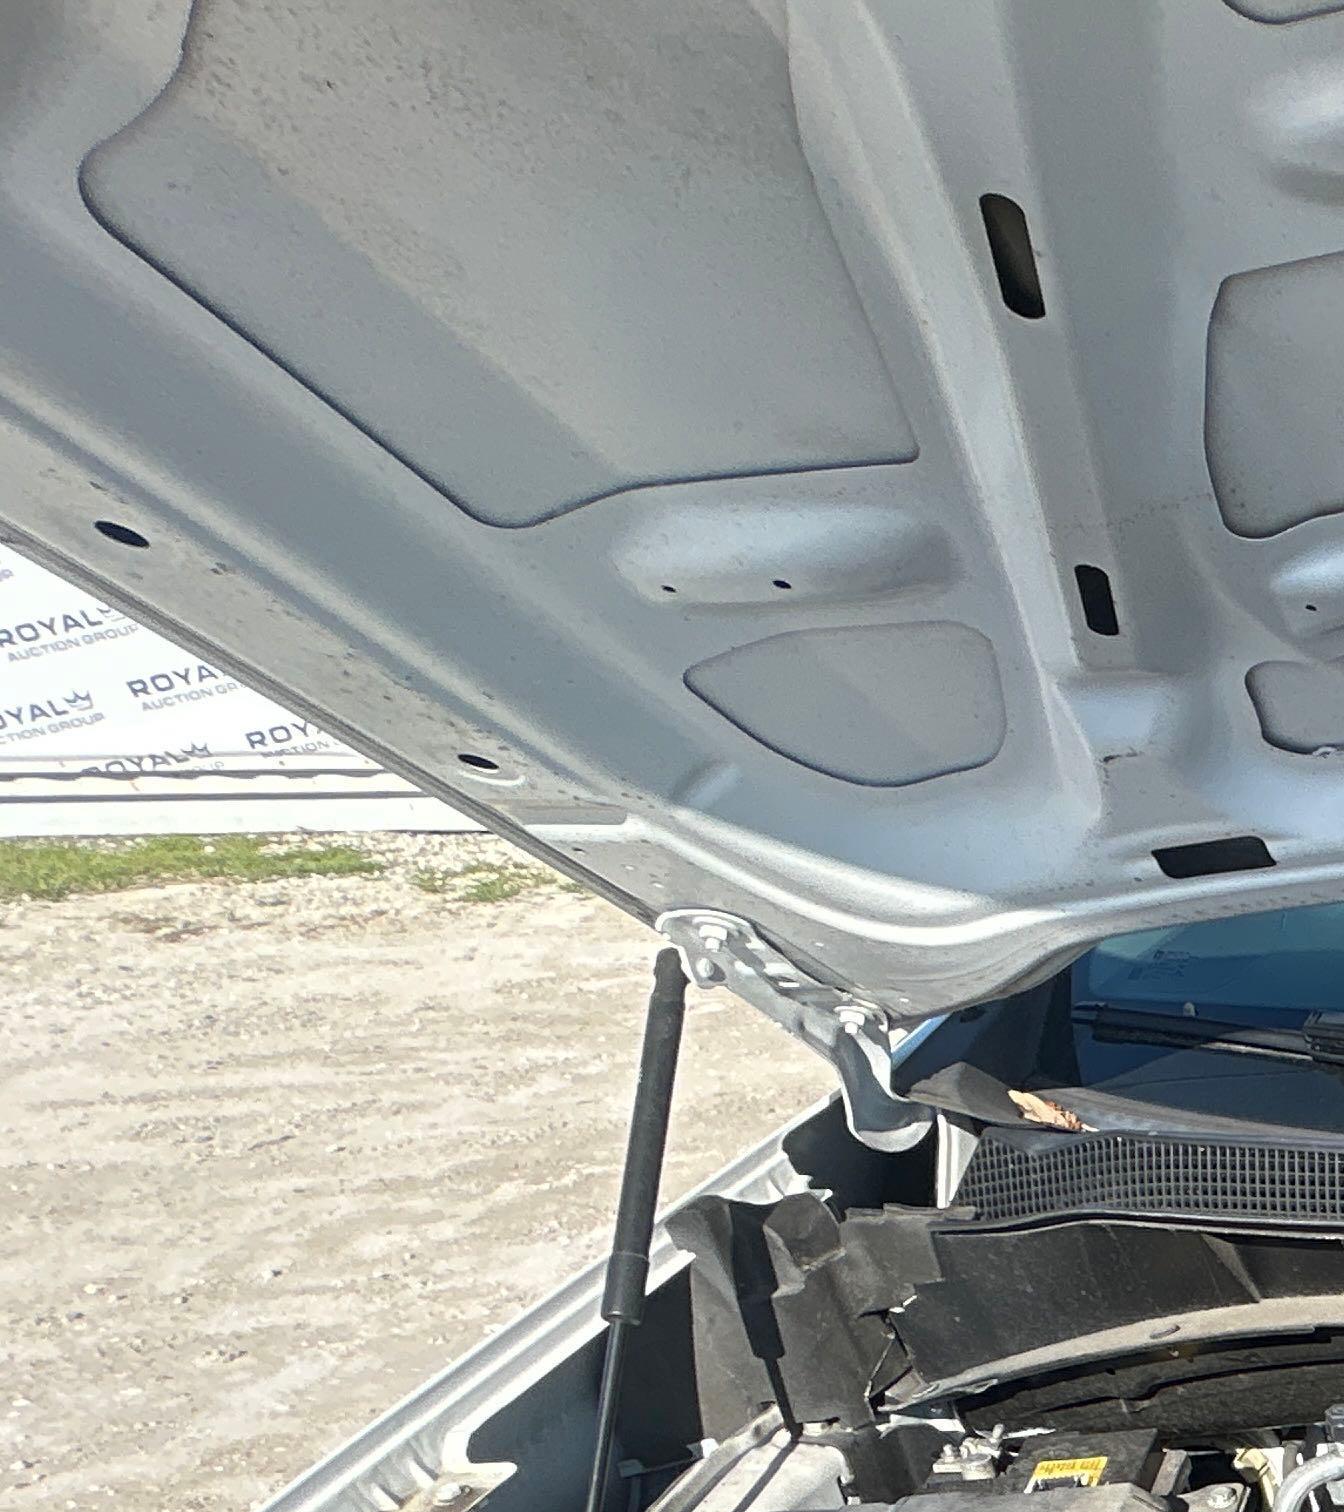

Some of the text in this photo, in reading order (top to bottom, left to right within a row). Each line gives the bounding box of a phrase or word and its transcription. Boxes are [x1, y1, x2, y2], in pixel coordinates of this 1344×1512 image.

[8, 624, 139, 662] AUCTION GROUP
[126, 665, 227, 698] ROYA
[142, 687, 213, 712] AUCTION
[47, 712, 105, 733] GROUP
[245, 720, 318, 749] ROY
